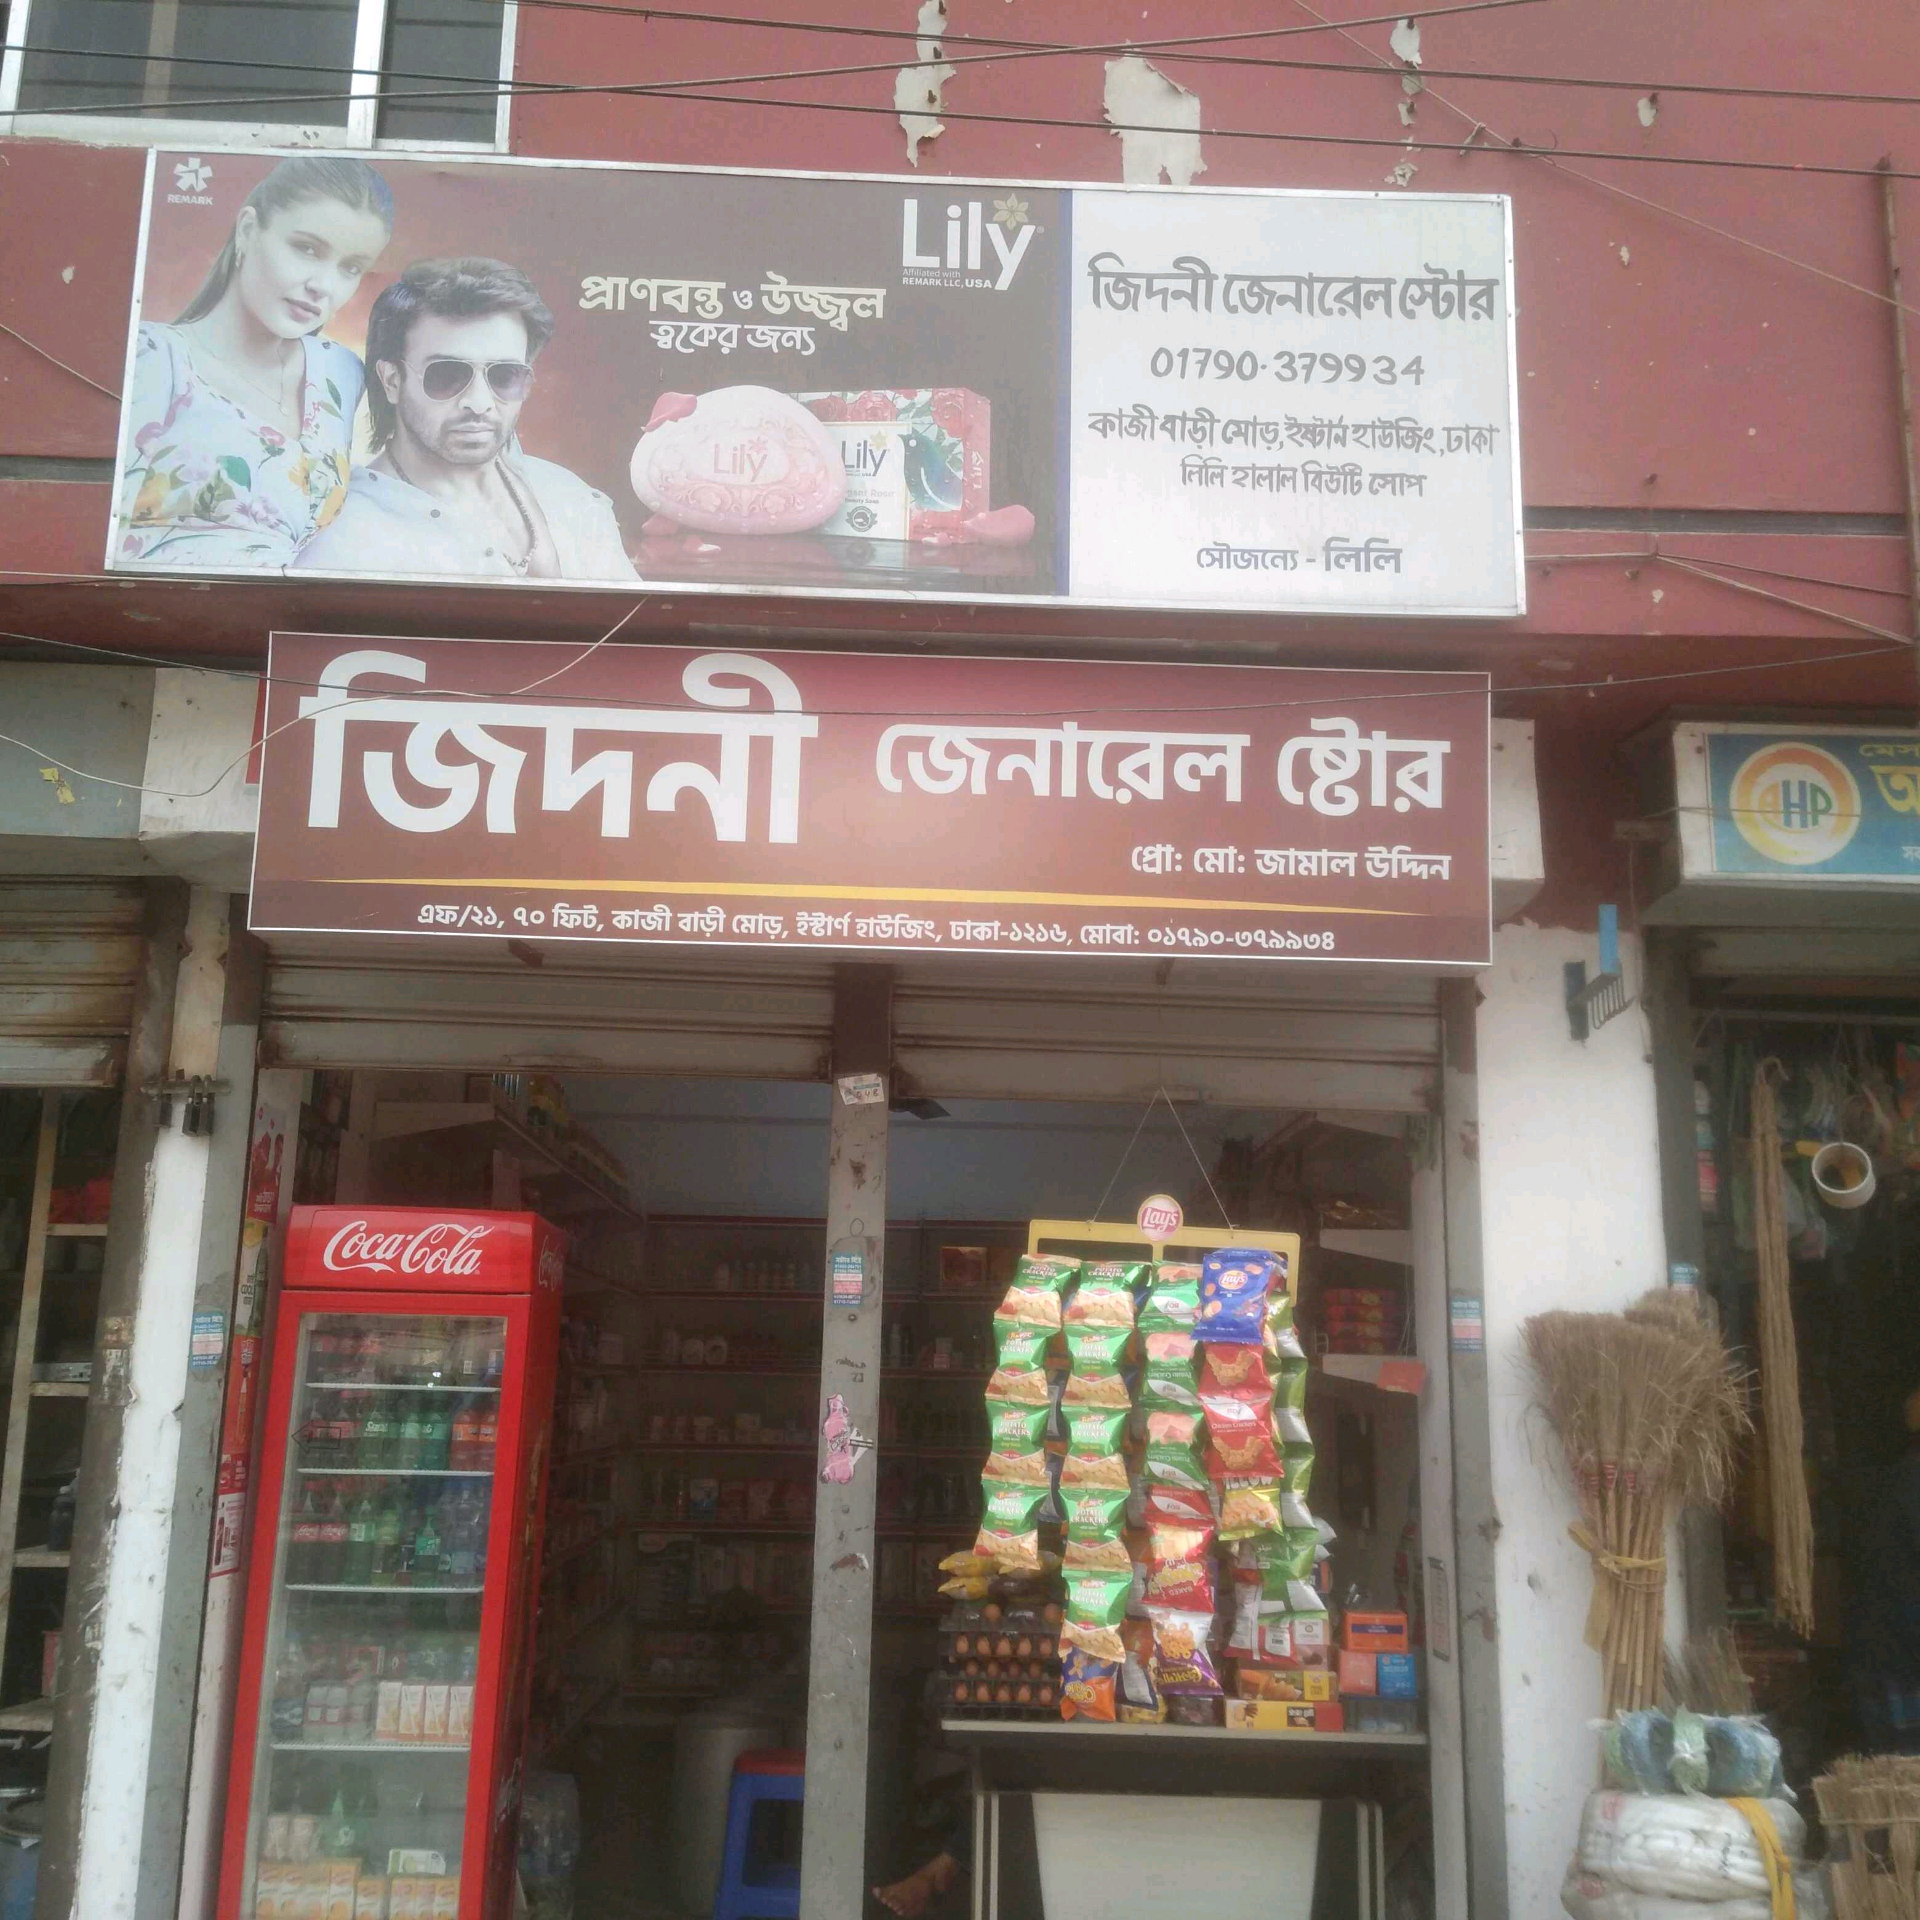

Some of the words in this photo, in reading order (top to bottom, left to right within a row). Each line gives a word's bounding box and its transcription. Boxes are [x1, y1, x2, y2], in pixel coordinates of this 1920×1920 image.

[167, 194, 213, 206] REMARK
[902, 198, 1037, 291] Lily
[902, 268, 941, 278] Affiliated
[942, 270, 961, 278] with
[902, 277, 942, 287] REMARK
[943, 278, 964, 289] LLC,
[965, 278, 993, 289] USA
[1087, 251, 1219, 314] জিদনী
[1222, 271, 1397, 320] জেনারেল
[1398, 262, 1500, 322] স্টোর
[579, 275, 727, 320] প্রাণবন্ত
[732, 290, 753, 309] ও
[760, 270, 887, 332] উজ্জ্বল
[649, 320, 742, 354] ত্বকের
[744, 323, 816, 356] জন্য
[1088, 403, 1159, 441] কাজী
[1159, 407, 1221, 450] বাড়ী
[1442, 423, 1500, 456] ঢাকা
[713, 443, 768, 483] Lily
[841, 440, 888, 477] Lily
[1180, 453, 1228, 488] লিলি
[1231, 462, 1298, 494] হালাল
[1300, 459, 1363, 496] বিউটি
[1368, 472, 1428, 497] সোপ
[1196, 541, 1299, 571] সৌজন্যে
[1322, 536, 1403, 573] লিলি
[298, 650, 820, 844] জিদনী
[876, 721, 1251, 806] জেনারেল
[1131, 842, 1182, 875] প্রো:
[1193, 846, 1246, 873] মো:
[1255, 848, 1358, 877] জামাল
[1365, 845, 1452, 881] উদ্দিন
[417, 903, 504, 929] এফ/২১,
[513, 907, 545, 926] ৭০
[552, 902, 604, 932] ফিট,
[612, 904, 672, 931] কাজী
[677, 905, 726, 938] বাড়ী
[732, 912, 789, 939] মোড়,
[855, 914, 943, 943] হাউজিং,
[949, 919, 1073, 947] ঢাকা-১২১৬,
[1080, 922, 1140, 946] মোবা:
[1148, 928, 1335, 951] ০১৭৯০-৩৭৯৯৩৪
[323, 1220, 495, 1275] Coca-Cola
[1022, 1268, 1058, 1277] CRACKERS
[1087, 1270, 1126, 1278] CRACKERS
[1071, 1516, 1109, 1526] CRACKERS
[1168, 1586, 1193, 1596] BAKED
